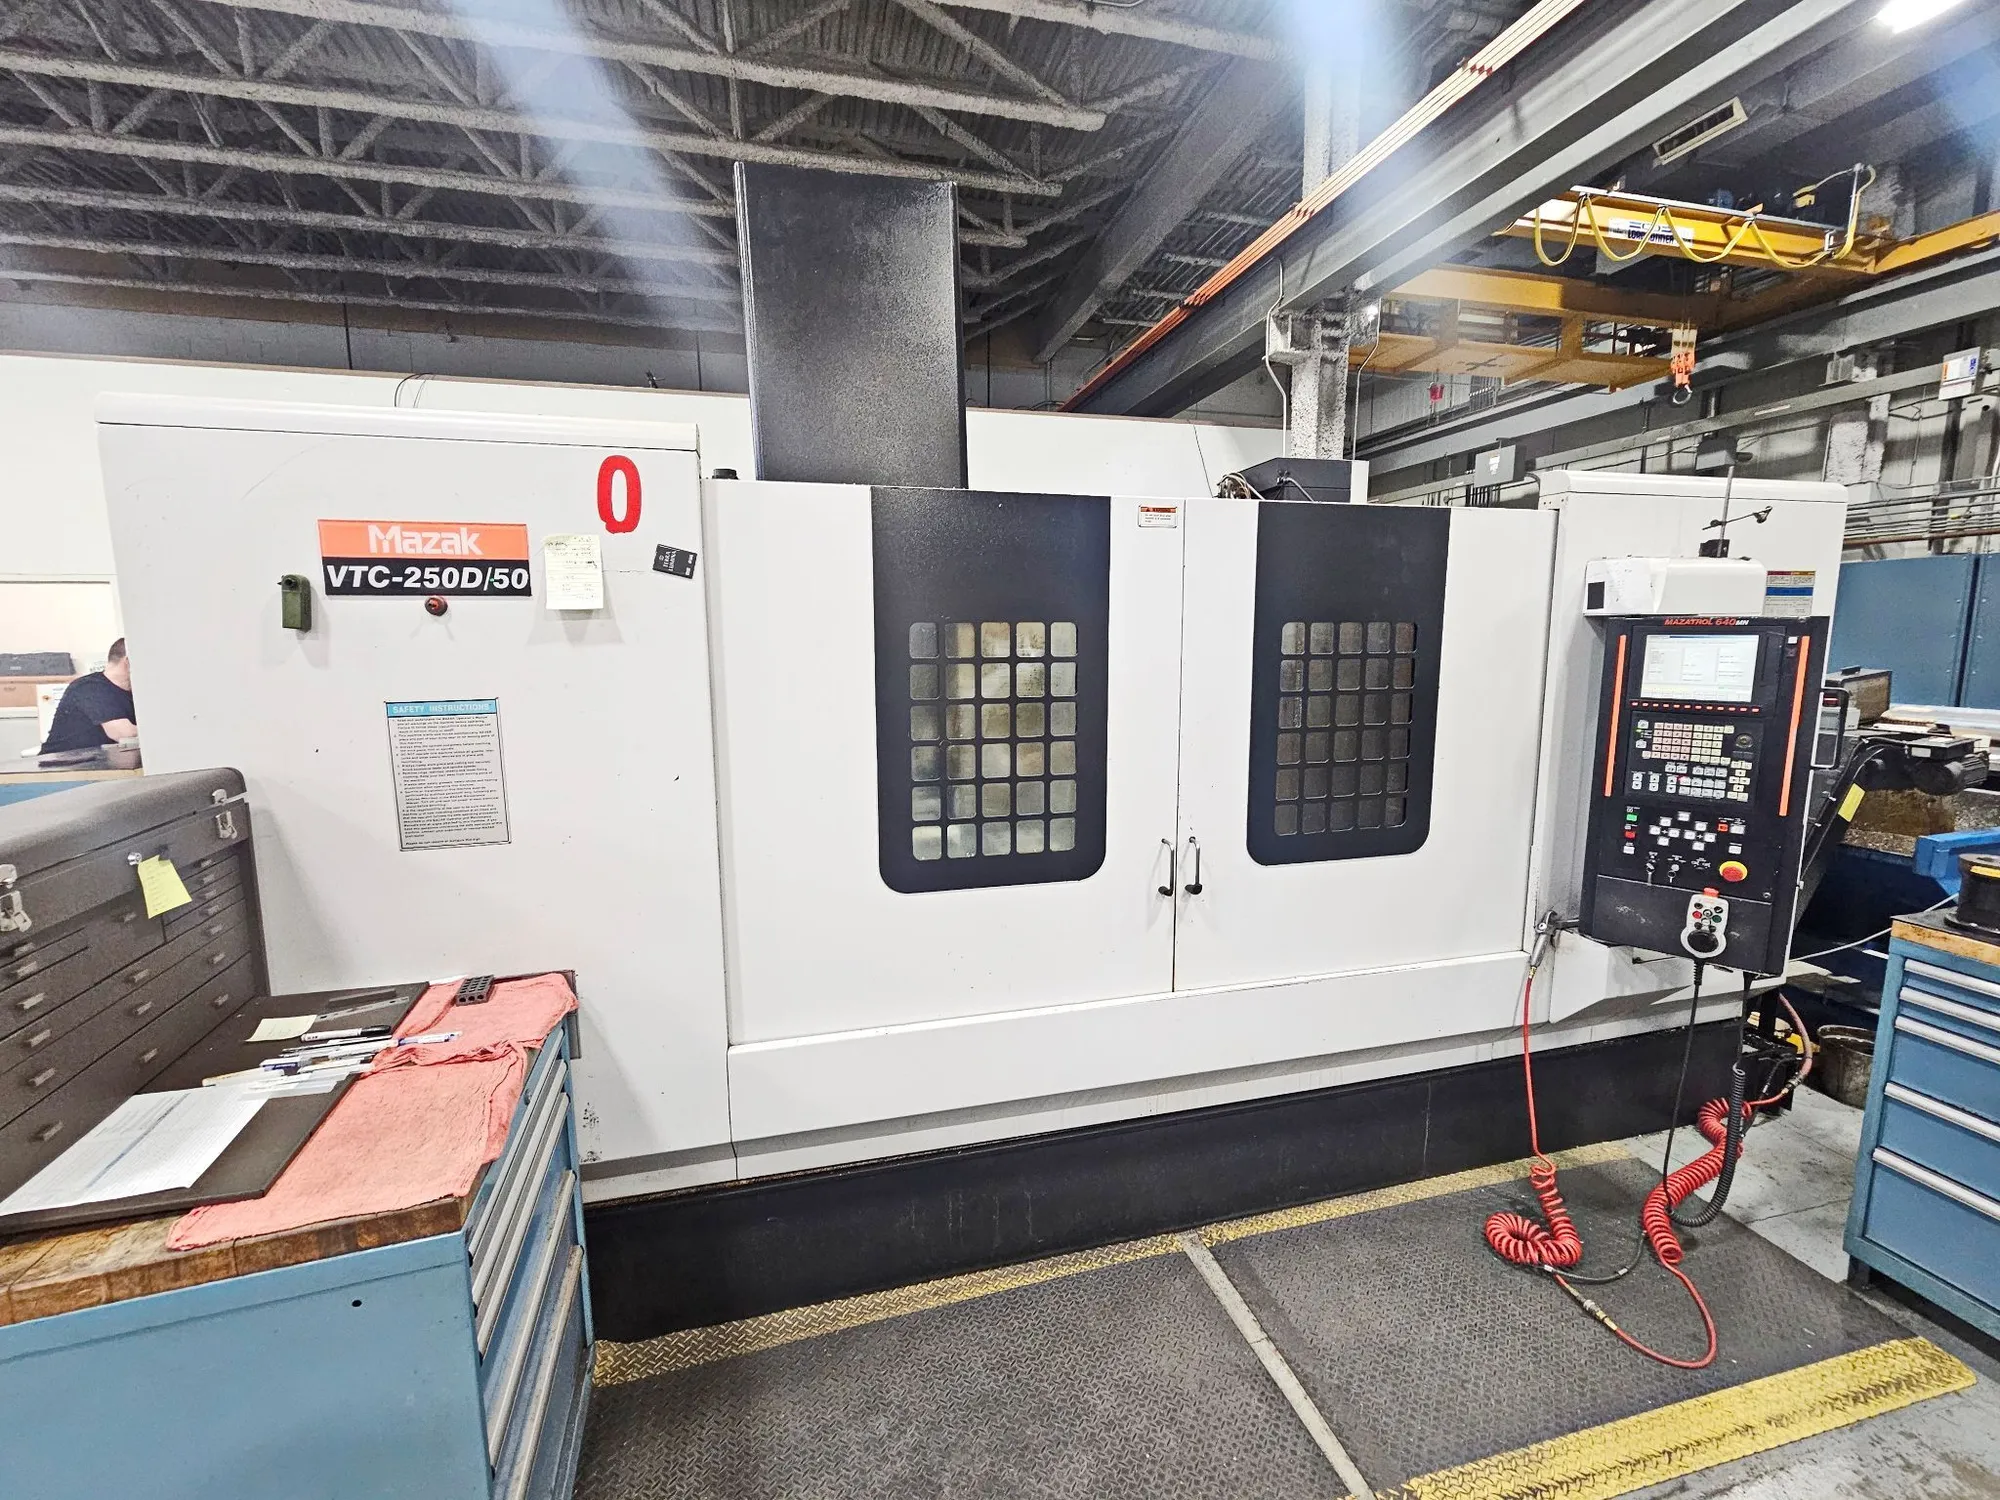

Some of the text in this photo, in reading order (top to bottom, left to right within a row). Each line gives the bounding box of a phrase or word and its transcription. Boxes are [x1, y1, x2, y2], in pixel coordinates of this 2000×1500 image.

[368, 524, 483, 556] Mazak
[326, 565, 529, 591] VTC-250D/50
[1664, 618, 1713, 626] MAZATROL
[392, 703, 490, 714] SAFETY INSTRUCTIONS
